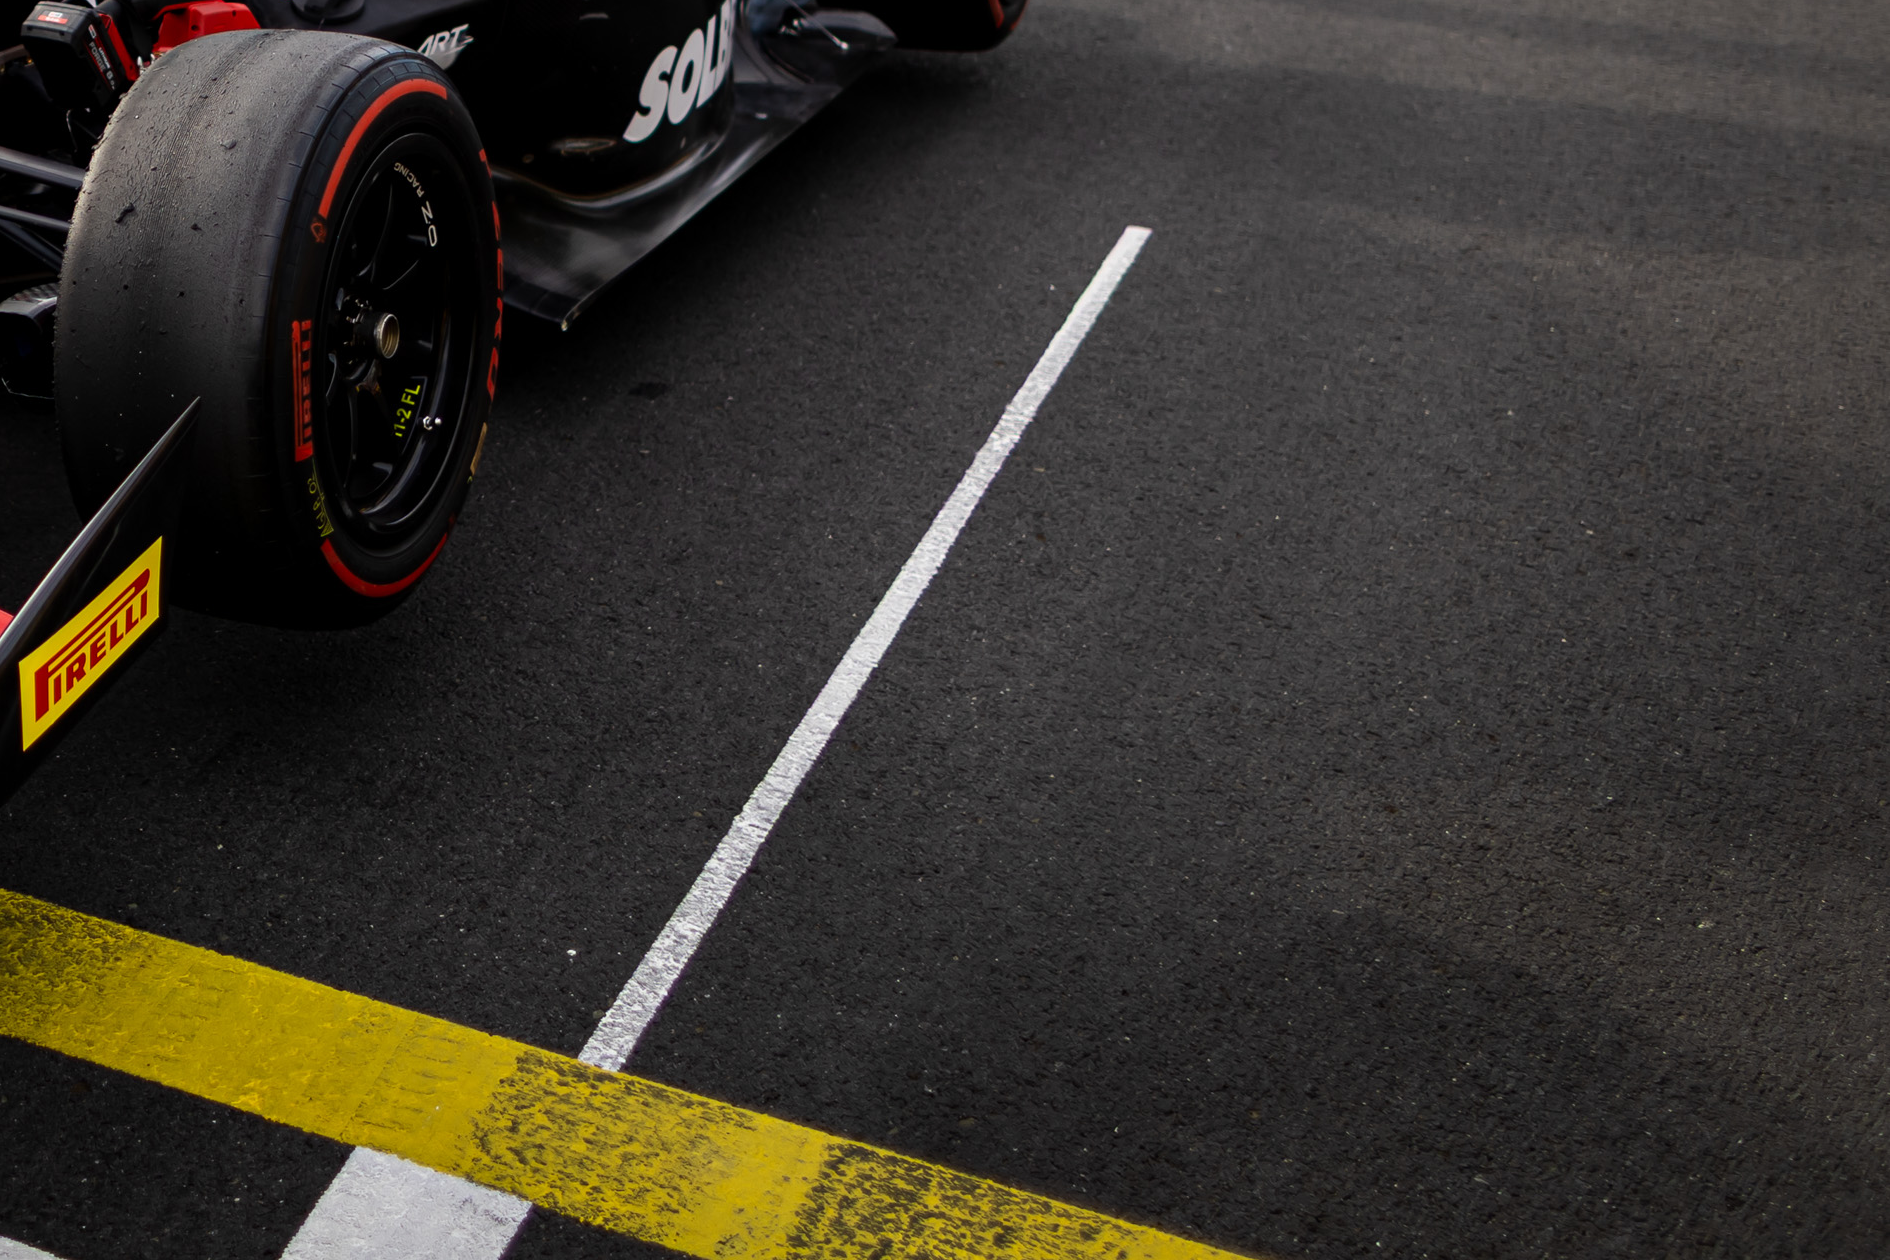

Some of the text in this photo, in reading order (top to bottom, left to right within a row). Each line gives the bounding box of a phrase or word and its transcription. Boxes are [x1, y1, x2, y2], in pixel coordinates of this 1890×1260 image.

[394, 162, 425, 198] RACING
[401, 385, 421, 406] FL
[35, 568, 150, 722] PIRELLI
